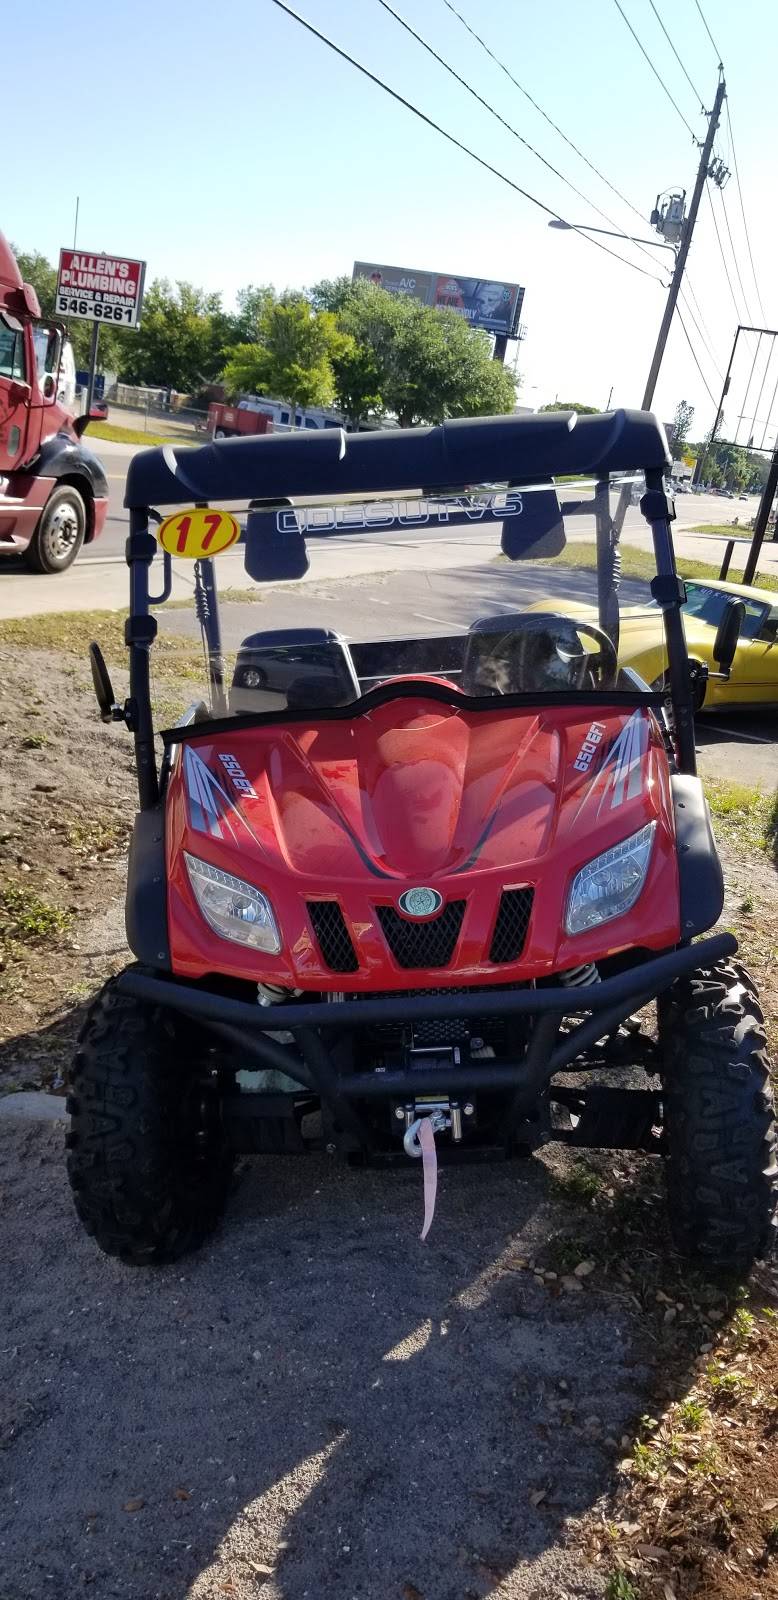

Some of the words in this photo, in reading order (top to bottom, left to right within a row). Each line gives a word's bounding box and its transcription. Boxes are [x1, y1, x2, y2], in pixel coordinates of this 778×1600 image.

[70, 255, 129, 278] ALLEN'S
[61, 269, 136, 295] PLUMBING
[59, 286, 94, 300] SERVICE
[94, 291, 102, 301] &
[103, 293, 135, 307] REPAIR
[59, 297, 133, 322] 546-6261
[176, 514, 223, 553] 17
[573, 744, 597, 772] 650
[585, 721, 607, 744] EFI
[218, 754, 246, 778] 650
[232, 778, 260, 800] EFI
